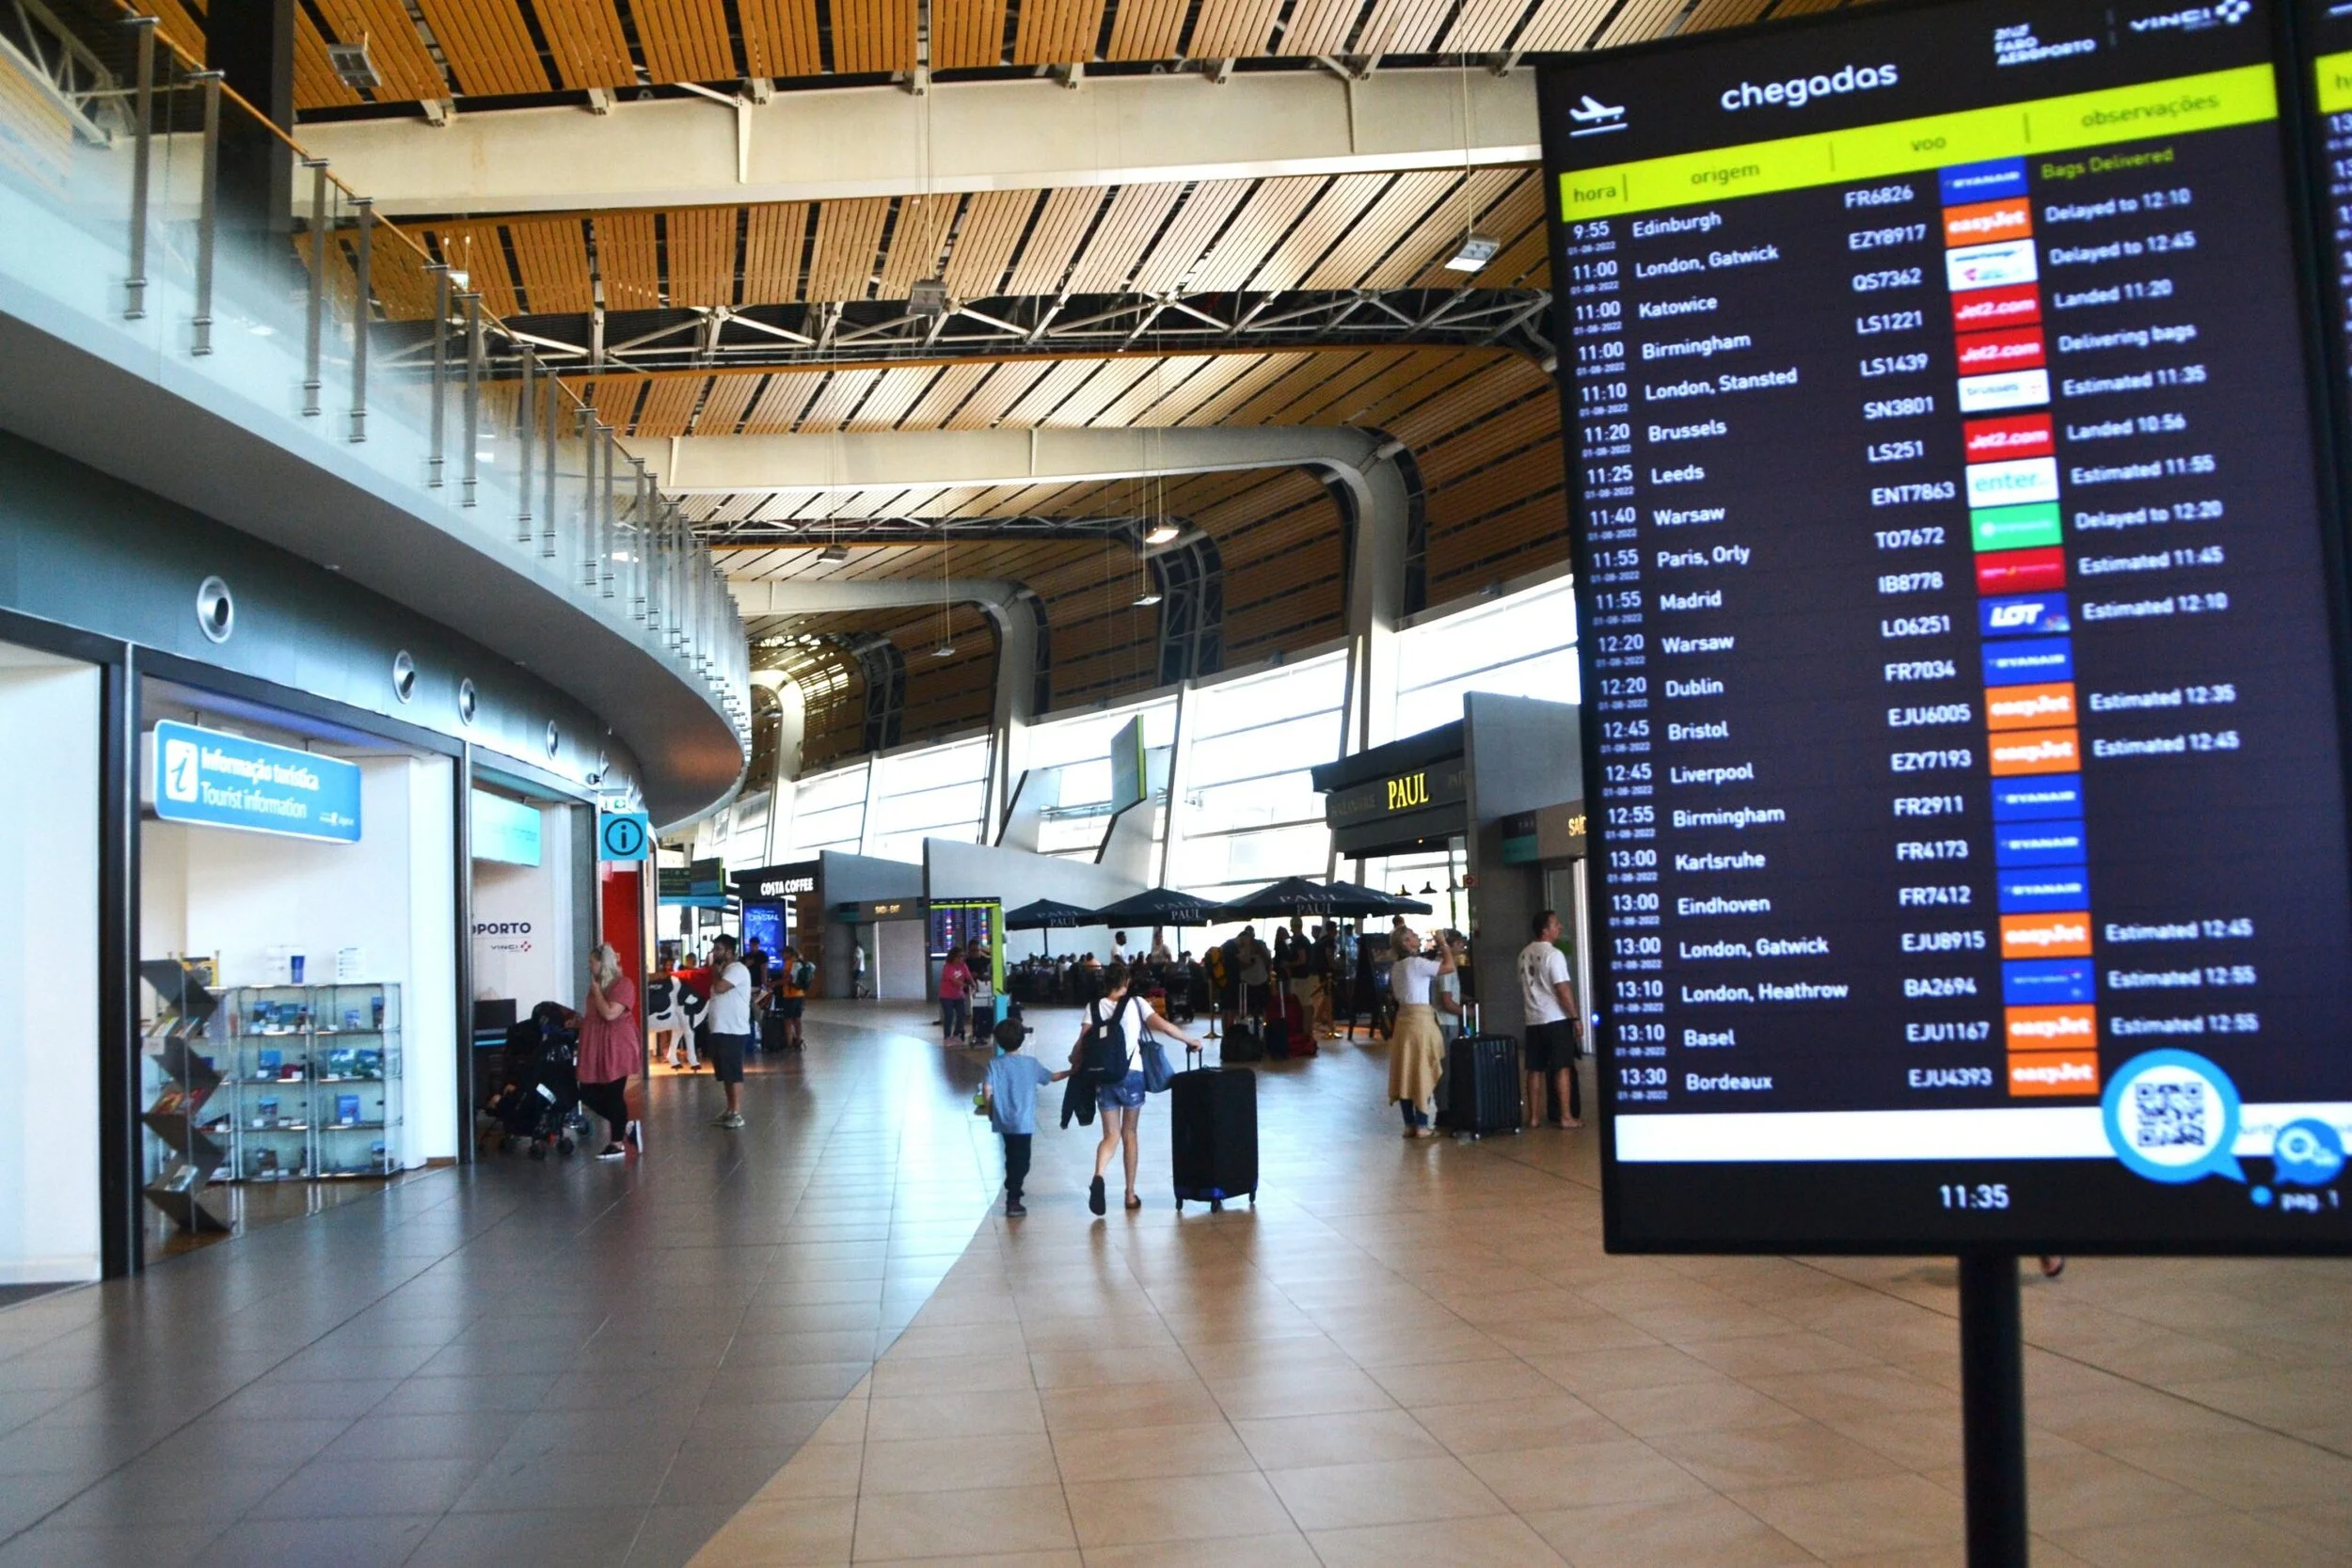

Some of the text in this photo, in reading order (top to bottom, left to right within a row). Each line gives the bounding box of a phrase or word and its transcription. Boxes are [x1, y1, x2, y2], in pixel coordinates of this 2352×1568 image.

[2130, 8, 2210, 31] VINCI
[1722, 64, 1898, 110] chegadas
[2081, 95, 2220, 128] observações
[1911, 137, 1947, 152] voo
[2042, 148, 2174, 179] Bags Delivered
[1691, 165, 1760, 185] origem
[1573, 187, 1616, 203] hora
[1845, 185, 1914, 208] FR6826
[2045, 188, 2191, 222] Delayed to 12:10
[1574, 221, 1610, 239] 9:55
[1632, 212, 1722, 237] Edinburgh
[1849, 224, 1926, 250] EZY8917
[2050, 231, 2196, 264] Delayed to 12:45
[1574, 261, 1617, 279] 11:00
[1636, 245, 1779, 277] London, Gatwick
[1852, 267, 1921, 292] QS7362
[2054, 279, 2172, 309] Landed 11:20
[1576, 301, 1621, 320] 11:00
[1639, 296, 1717, 318] Katowice
[1857, 310, 1922, 334] LS1221
[1642, 335, 1751, 359] Birmingham
[2058, 325, 2196, 352] Delivering bags
[1579, 341, 1624, 360] 11:00
[1861, 353, 1928, 376] LS1439
[1645, 368, 1798, 401] London, Stansted
[2063, 365, 2206, 396] Estimated 11:35
[1582, 383, 1627, 402] 11:10
[1864, 396, 1933, 420] SN3801
[1585, 423, 1629, 442] 11:20
[1648, 420, 1727, 442] Brussels
[2067, 414, 2185, 440] Landed 10:56
[1868, 440, 1923, 462] LS251
[1588, 465, 1633, 483] 11:25
[1651, 465, 1705, 483] Leeds
[2072, 454, 2215, 484] Estimated 11:55
[1871, 482, 1955, 505] ENT7863
[1591, 507, 1636, 525] 11:40
[1654, 508, 1724, 525] Warsaw
[2075, 500, 2222, 530] Delayed to 12:20
[1875, 527, 1944, 548] TO7672
[1594, 548, 1639, 567] 11:55
[1658, 545, 1750, 567] Paris, Orly
[2079, 551, 2170, 575] Estimated
[2174, 546, 2223, 564] 11:45
[1879, 572, 1943, 593] IB8778
[1597, 591, 1642, 609] 11:55
[1661, 590, 1722, 610] Madrid
[2083, 593, 2228, 620] Estimated 12:10
[1991, 604, 2043, 626] LOT
[1882, 615, 1949, 637] LO6251
[1599, 634, 1644, 652] 12:20
[1662, 637, 1734, 653] Warsaw
[1885, 660, 1956, 681] FR7034
[1601, 676, 1646, 694] 12:20
[1666, 678, 1724, 697] Dublin
[2090, 684, 2235, 710] Estimated 12:35
[1888, 704, 1971, 726] EJU6005
[1604, 720, 1649, 737] 12:45
[1668, 721, 1729, 740] Bristol
[2093, 731, 2239, 757] Estimated 12:45
[201, 747, 272, 785] Informação
[1891, 750, 1971, 771] EZY7193
[1606, 763, 1652, 781] 12:45
[1671, 762, 1754, 784] Liverpool
[200, 781, 307, 818] Tourist information
[1388, 773, 1429, 810] PAUL
[1609, 805, 1654, 824] 12:55
[1894, 796, 1963, 816] FR2911
[1674, 807, 1785, 829] Birmingham
[1611, 849, 1657, 867] 13:00
[1676, 851, 1766, 870] Karlsruhe
[1897, 840, 1968, 860] FR4173
[760, 878, 814, 895] COSTA COFFEE
[1899, 886, 1970, 905] FR7412
[1297, 903, 1332, 914] PAUL
[1613, 893, 1659, 911] 13:00
[1677, 896, 1771, 915] Eindhoven
[1050, 917, 1077, 927] PAUL
[1171, 909, 1200, 920] PAUL
[2106, 918, 2252, 942] Estimated 12:45
[1615, 937, 1661, 955] 13:00
[1680, 937, 1829, 958] London, Gatwick
[1902, 930, 1985, 952] EJU8915
[1904, 977, 1977, 997] BA2694
[2108, 966, 2255, 988] Estimated 12:55
[1617, 980, 1663, 997] 13:10
[1682, 982, 1848, 1003] London, Heathrow
[1619, 1024, 1665, 1041] 13:10
[1907, 1022, 1990, 1041] EJU1167
[2111, 1013, 2258, 1035] Estimated 12:55
[1684, 1029, 1735, 1047] Basel
[1621, 1068, 1667, 1085] 13:30
[1686, 1073, 1772, 1090] Bordeaux
[1909, 1068, 1992, 1087] EJU4393
[1941, 1184, 2009, 1208] 11:35
